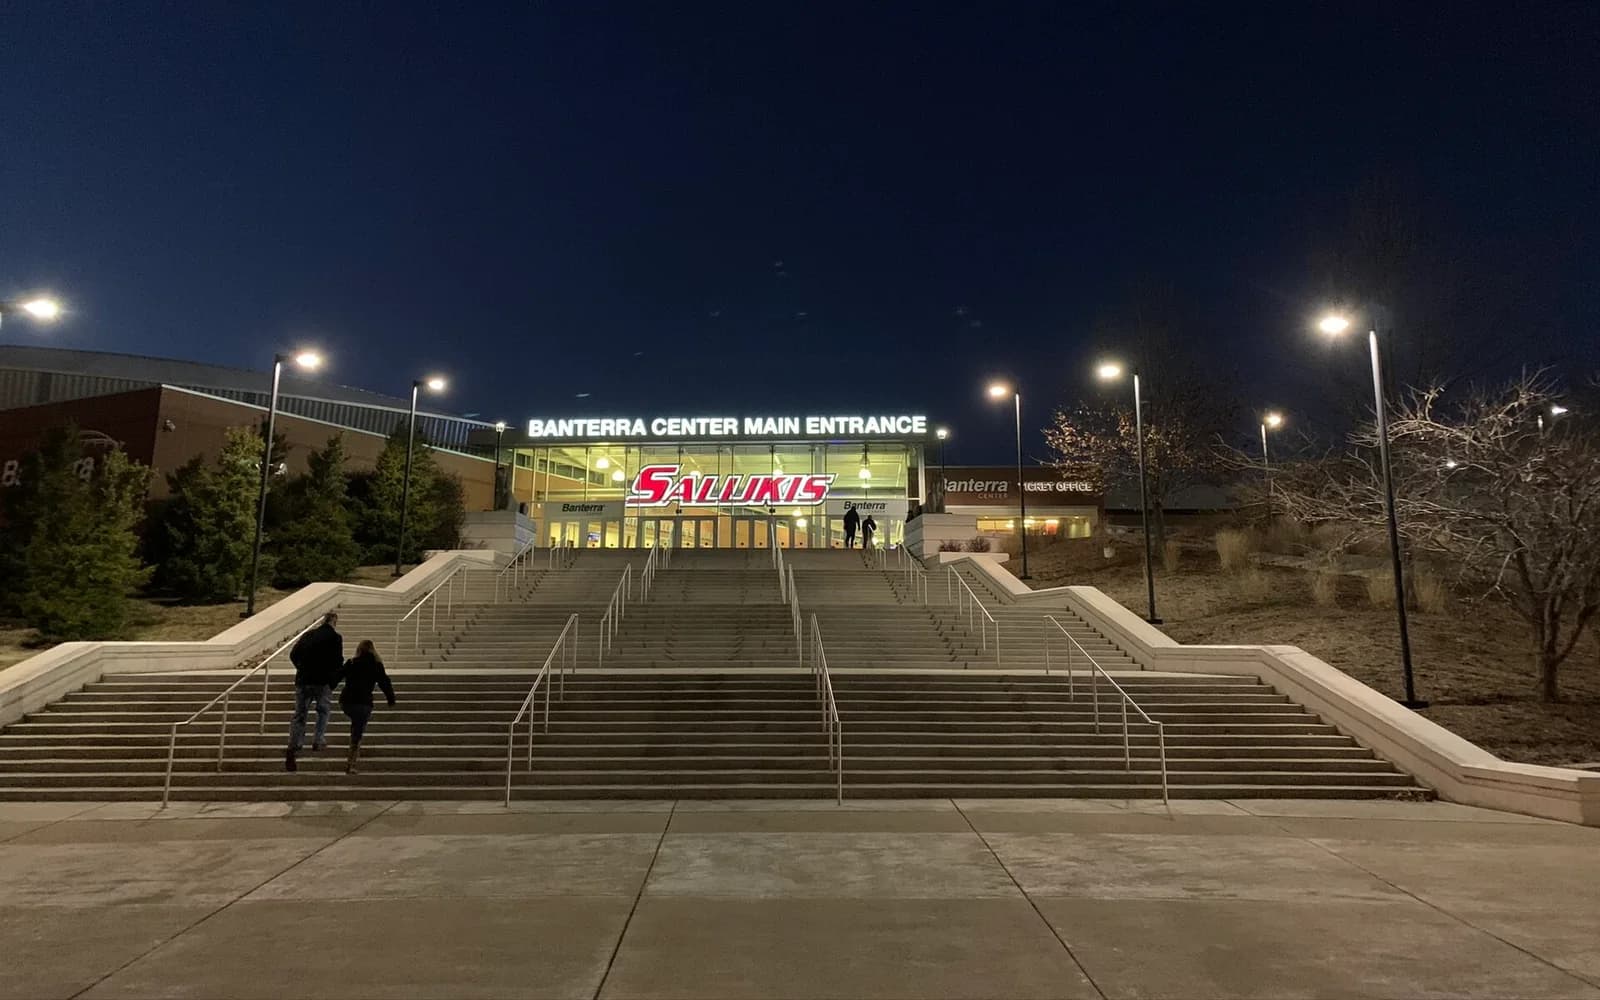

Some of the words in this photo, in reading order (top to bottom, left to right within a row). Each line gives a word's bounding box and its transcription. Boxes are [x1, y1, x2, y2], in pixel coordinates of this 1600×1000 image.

[528, 419, 647, 437] BANTERRA
[651, 418, 738, 436] CENTER
[744, 417, 800, 435] MAIN
[806, 416, 927, 434] ENTRANCE
[625, 463, 838, 506] SALUKIS
[1017, 481, 1055, 492] ICKET
[1056, 481, 1093, 492] OFFICE
[562, 503, 604, 512] Banterra
